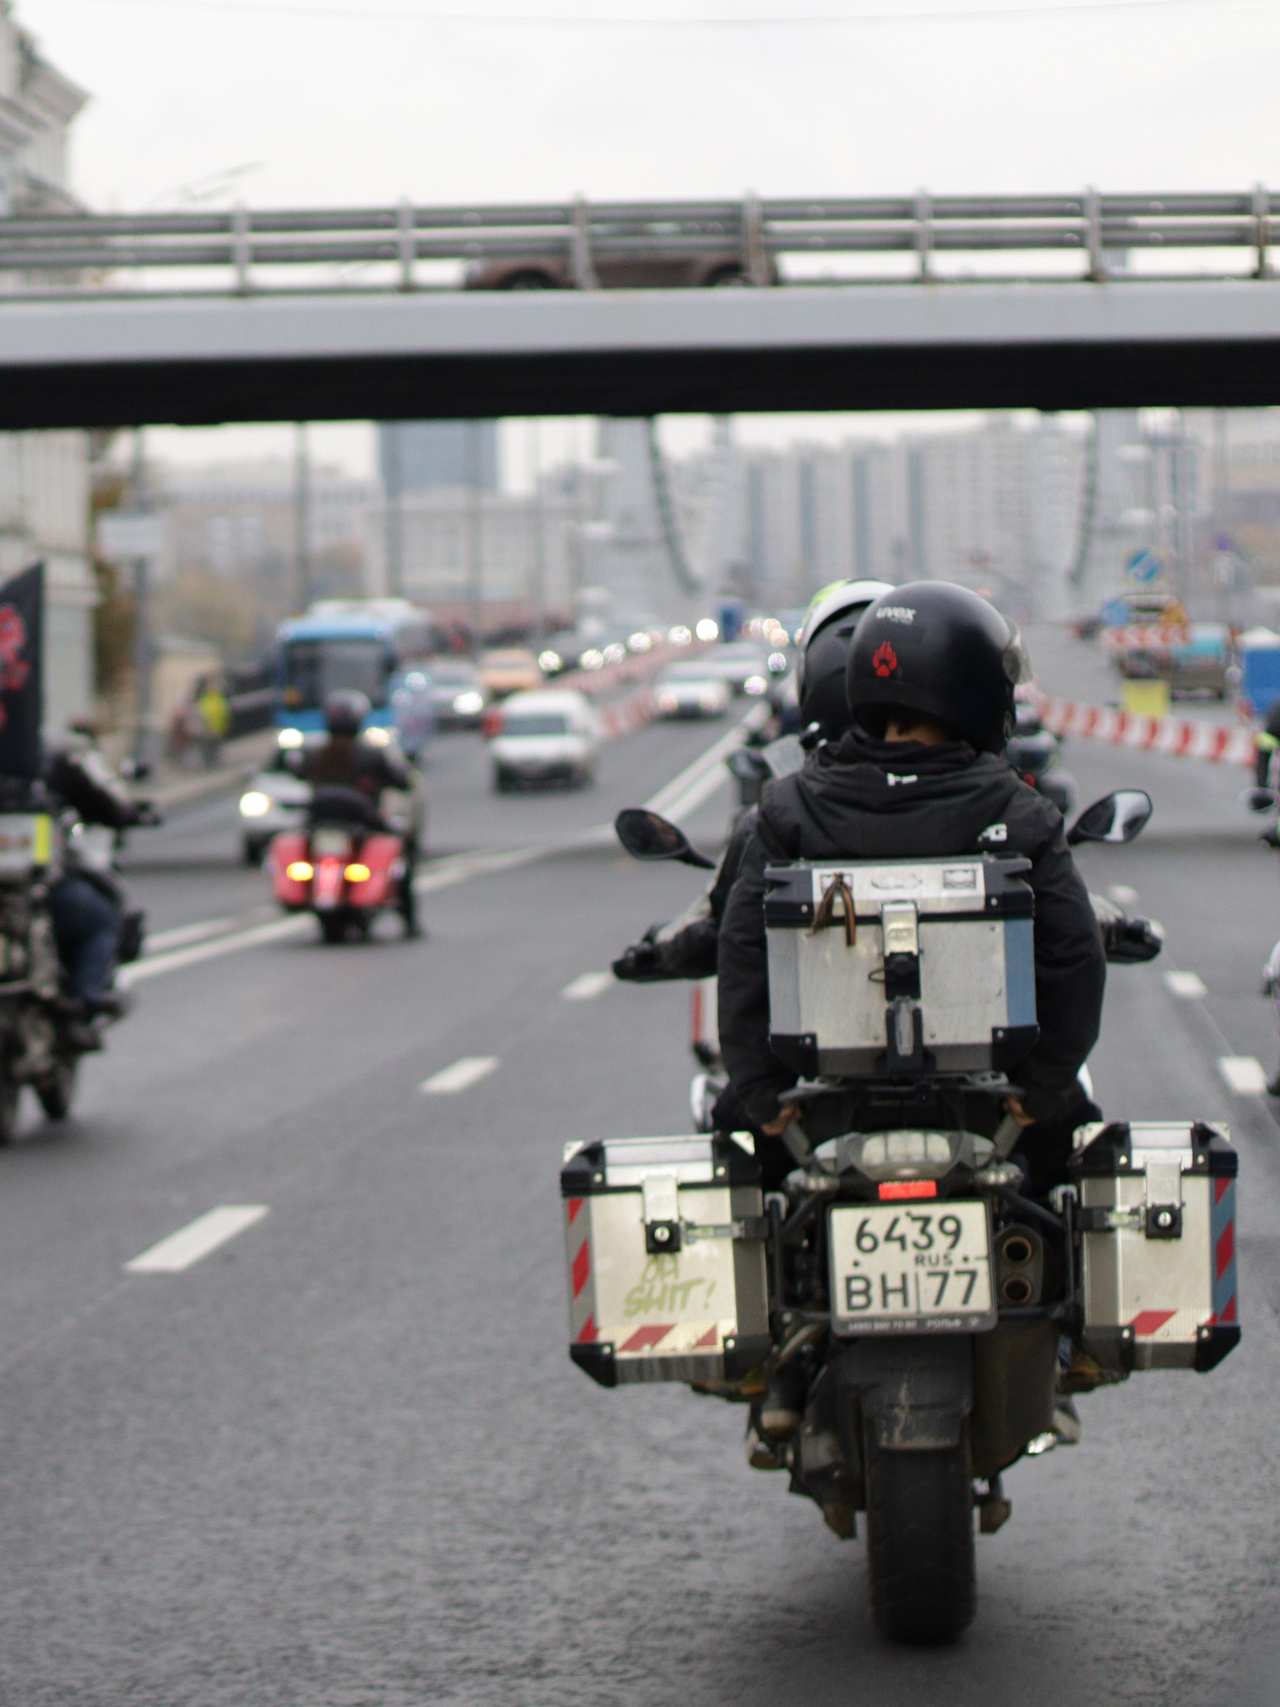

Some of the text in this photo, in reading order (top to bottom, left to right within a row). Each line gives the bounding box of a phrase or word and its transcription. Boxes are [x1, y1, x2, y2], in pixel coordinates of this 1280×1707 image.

[855, 1214, 963, 1254] 6439
[915, 1253, 953, 1267] RUS
[927, 1269, 978, 1307] 77
